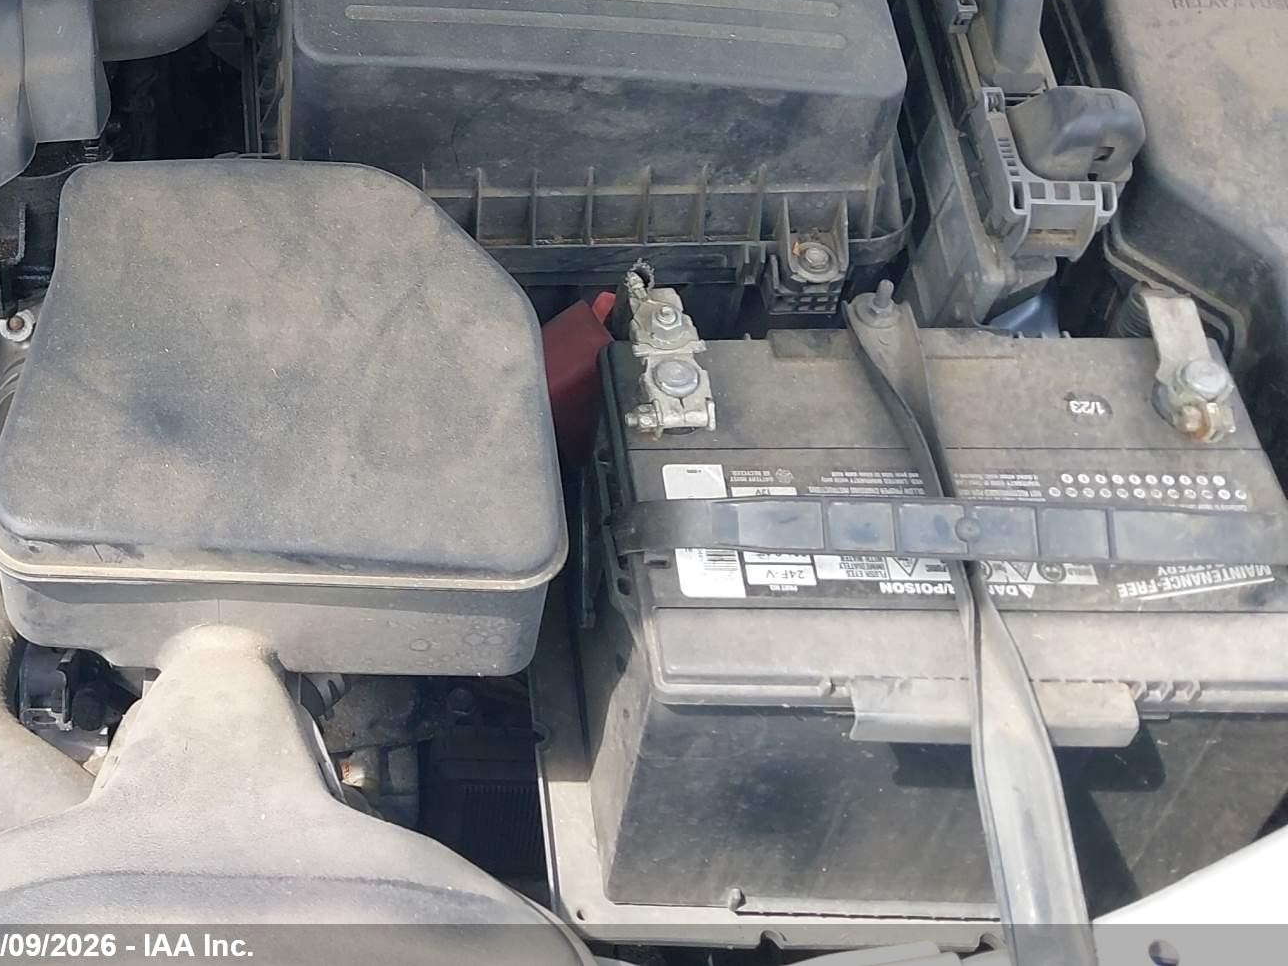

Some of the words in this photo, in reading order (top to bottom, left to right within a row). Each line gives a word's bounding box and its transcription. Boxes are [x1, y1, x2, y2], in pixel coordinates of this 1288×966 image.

[1070, 401, 1106, 415] 1/23
[765, 569, 806, 579] 24F-V
[1115, 565, 1273, 597] MAINTENANCE-FREE
